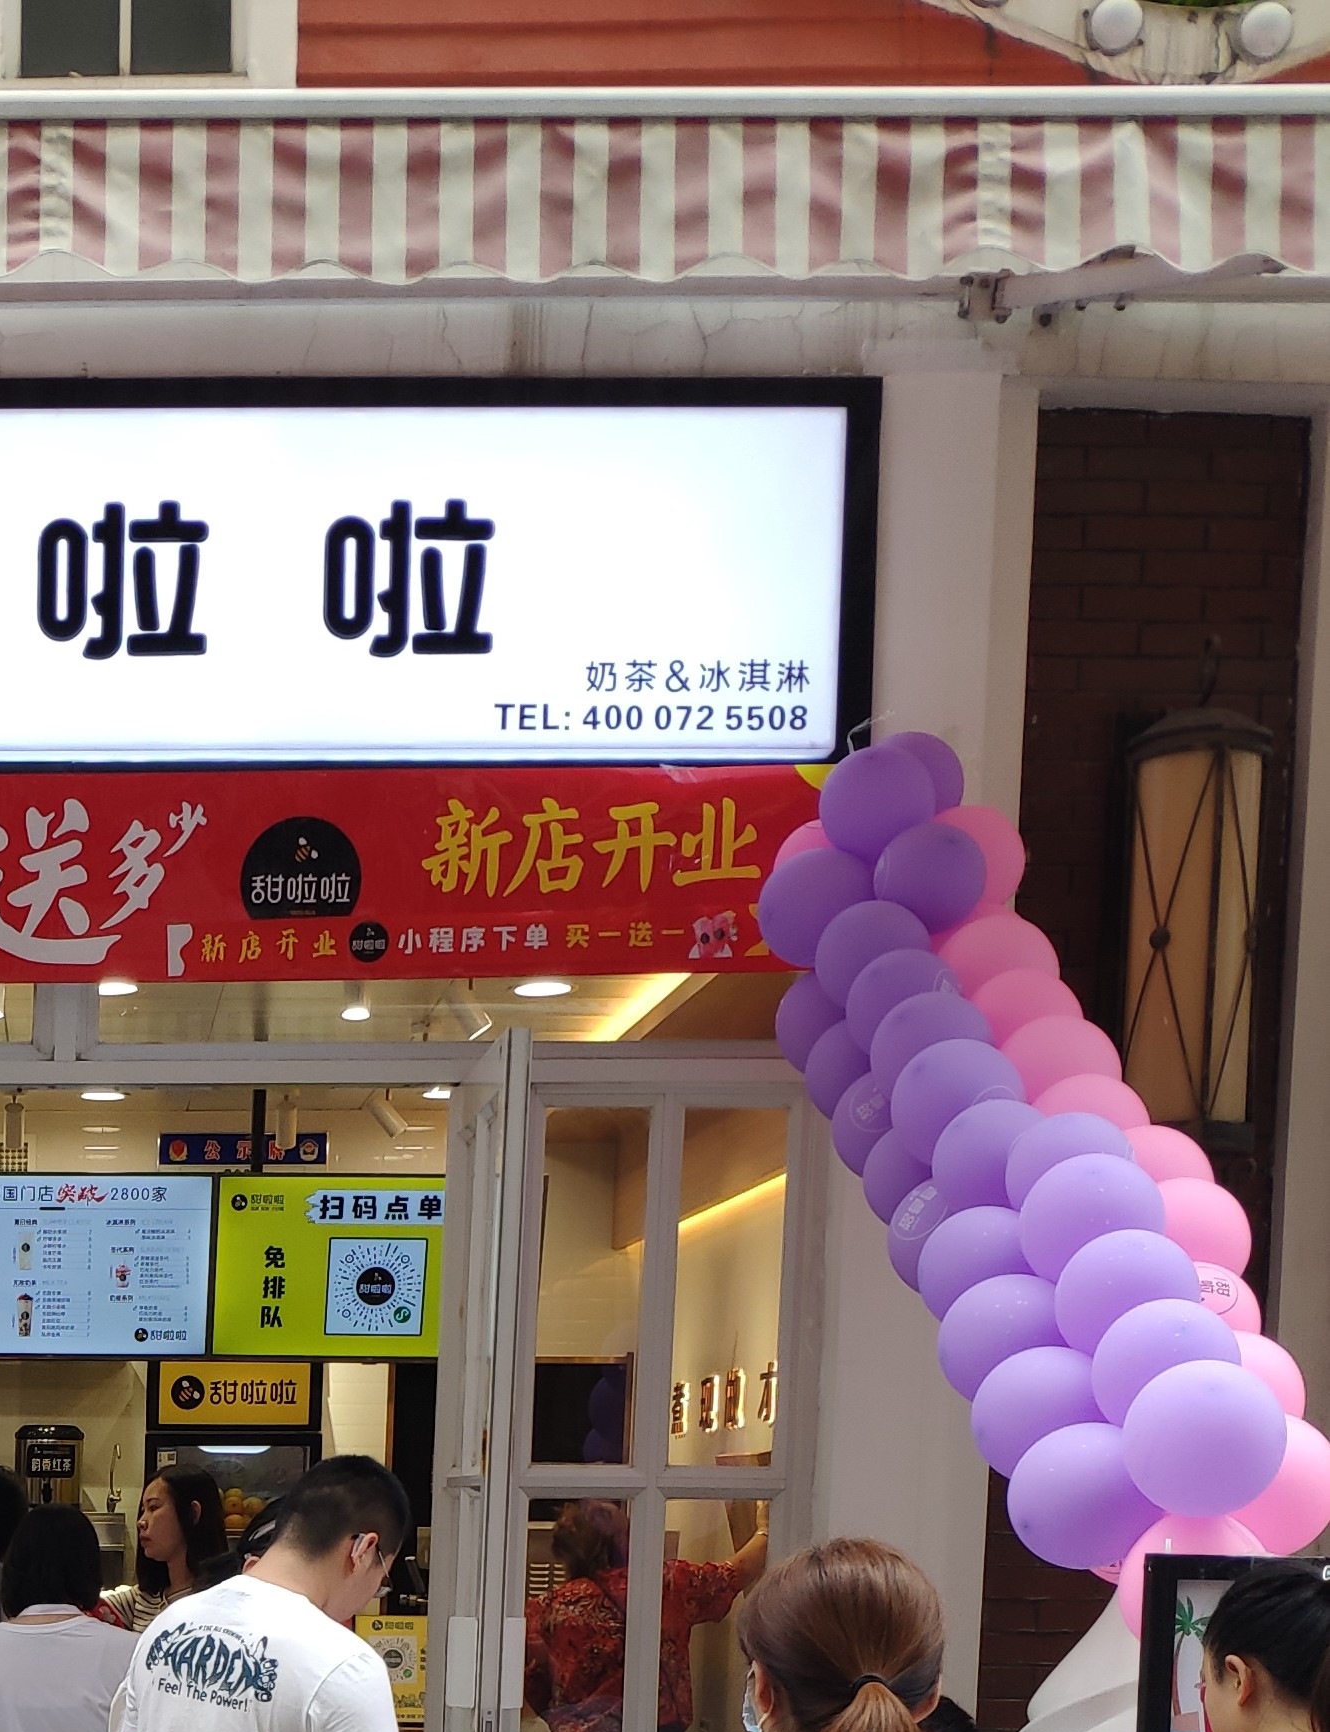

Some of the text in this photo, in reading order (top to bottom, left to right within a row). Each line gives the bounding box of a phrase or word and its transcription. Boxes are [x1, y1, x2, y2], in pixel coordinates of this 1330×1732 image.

[586, 659, 810, 692] 奶茶&冰淇淋
[494, 703, 808, 731] TEL: 400 072 5508
[422, 797, 761, 898] 新店开业
[251, 872, 351, 903] 甜啦啦
[201, 928, 337, 963] 新店开业
[397, 922, 684, 955] 小程序下单 买一送一
[319, 1195, 442, 1220] 扫码点单
[260, 1246, 286, 1328] 免排队
[210, 1379, 297, 1405] 甜啦啦
[158, 1678, 182, 1696] Feel
